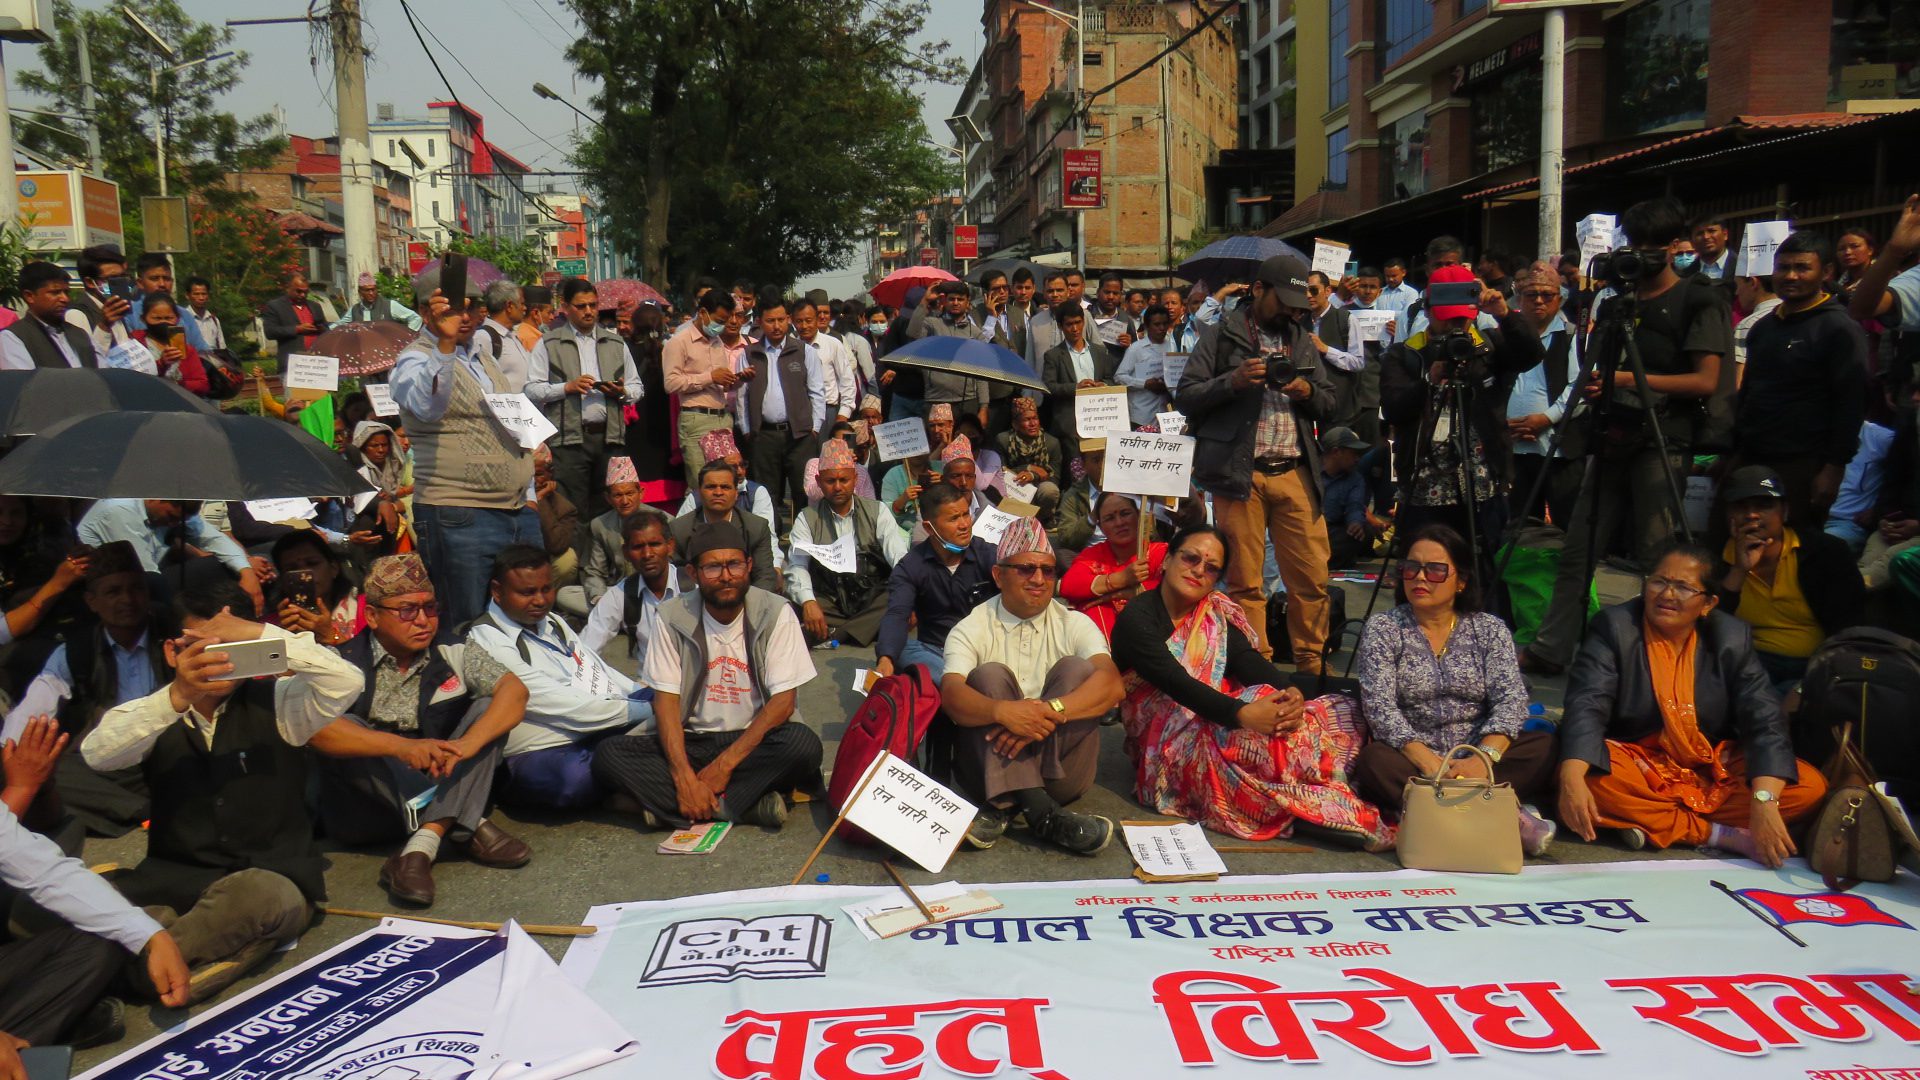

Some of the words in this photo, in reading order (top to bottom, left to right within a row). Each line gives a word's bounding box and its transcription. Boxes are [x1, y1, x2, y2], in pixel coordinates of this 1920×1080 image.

[1469, 49, 1506, 80] HELMETS
[1290, 277, 1309, 288] Reeb
[1119, 435, 1151, 449] संघीय
[1153, 437, 1183, 452] शिक्षा
[1117, 454, 1135, 469] ऐन
[1139, 458, 1163, 471] जारी
[872, 785, 895, 804] ऐन
[898, 801, 928, 824] जारी
[887, 765, 925, 792] संघीय
[924, 787, 961, 815] शिक्षा
[1075, 894, 1155, 907] अधिकार
[1168, 895, 1180, 905] र
[1326, 888, 1392, 901] शिक्षक
[1400, 887, 1457, 899] एकता
[1119, 907, 1334, 940] शिक्षक
[1352, 898, 1651, 933] महासङ्घ
[679, 924, 802, 947] cnt
[1305, 941, 1393, 960] समिति
[195, 983, 343, 1056] अनुदान
[317, 935, 436, 987] शिक्षक
[364, 976, 427, 1009] नेपाल
[1152, 967, 1603, 1066] विरोध
